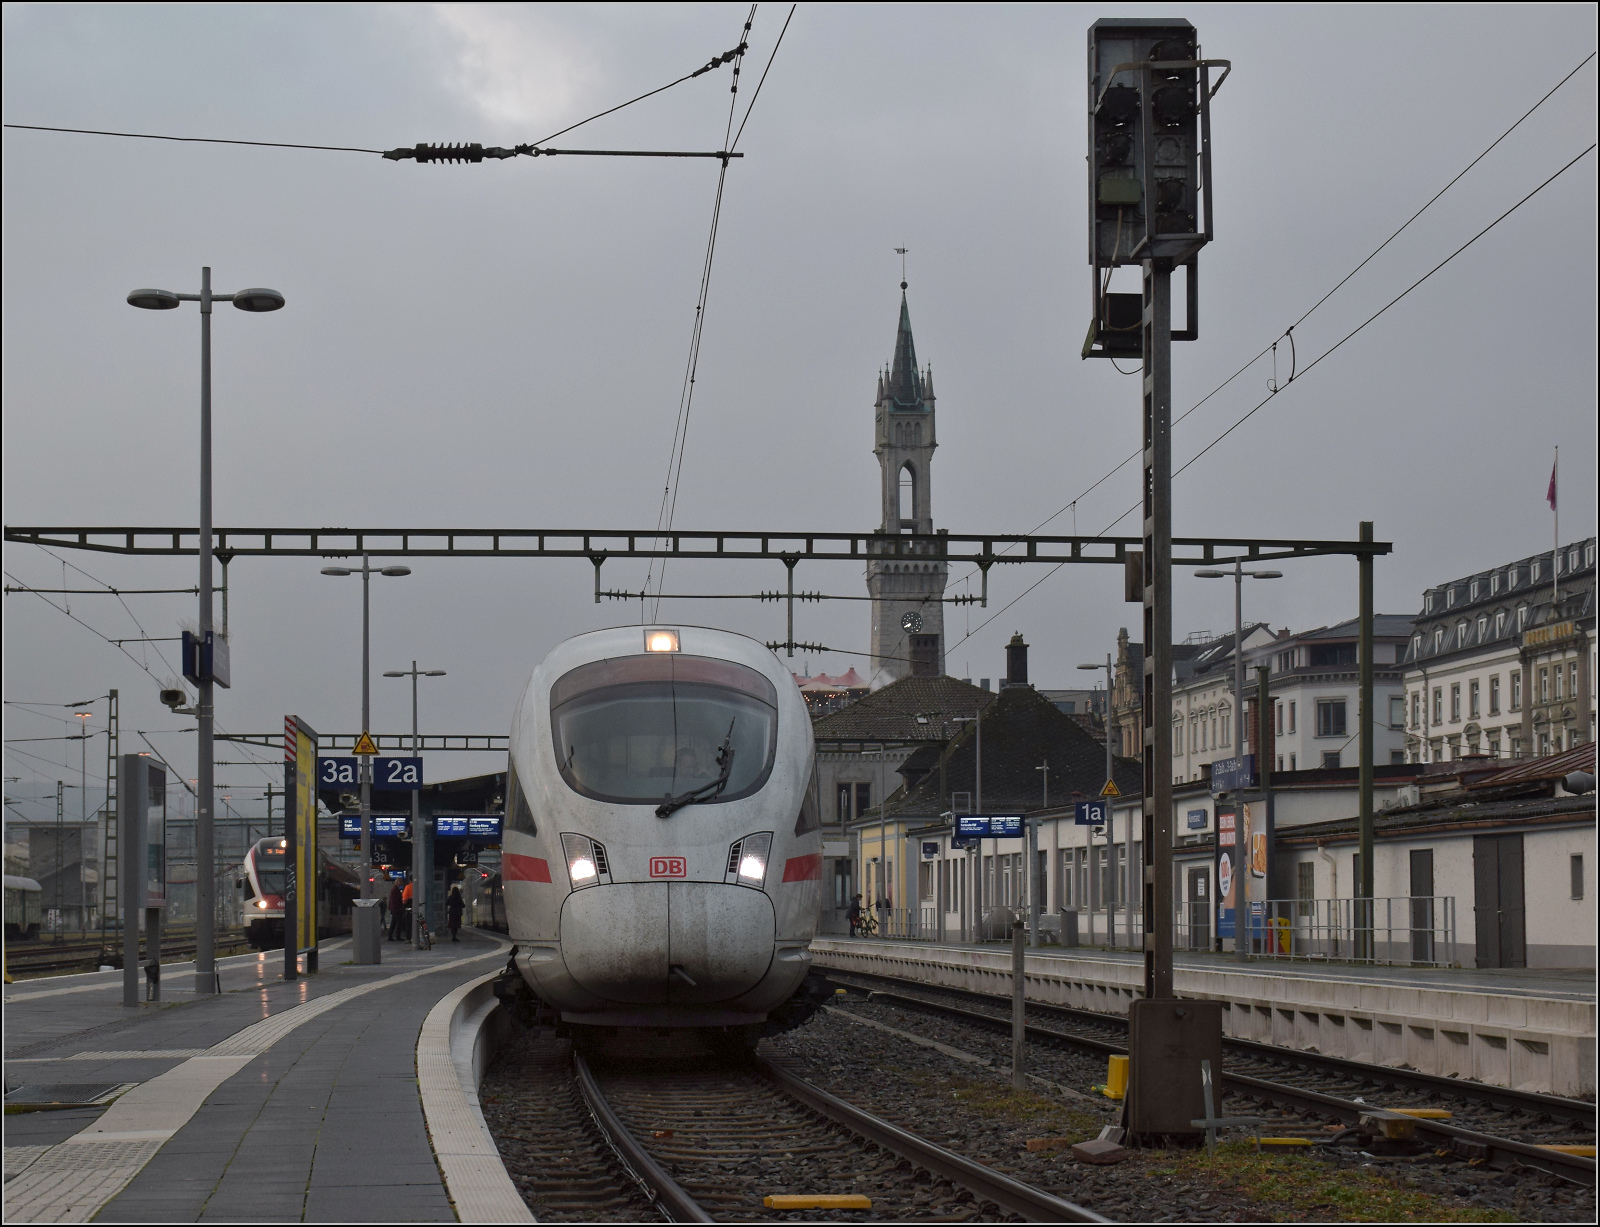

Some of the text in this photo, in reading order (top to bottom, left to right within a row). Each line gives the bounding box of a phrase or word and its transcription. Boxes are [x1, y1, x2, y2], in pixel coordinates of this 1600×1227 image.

[322, 759, 354, 783] 3a
[387, 759, 419, 783] 2a
[1081, 803, 1102, 821] 1a
[373, 851, 388, 863] 3a
[462, 851, 477, 862] 2a
[654, 860, 682, 875] DB
